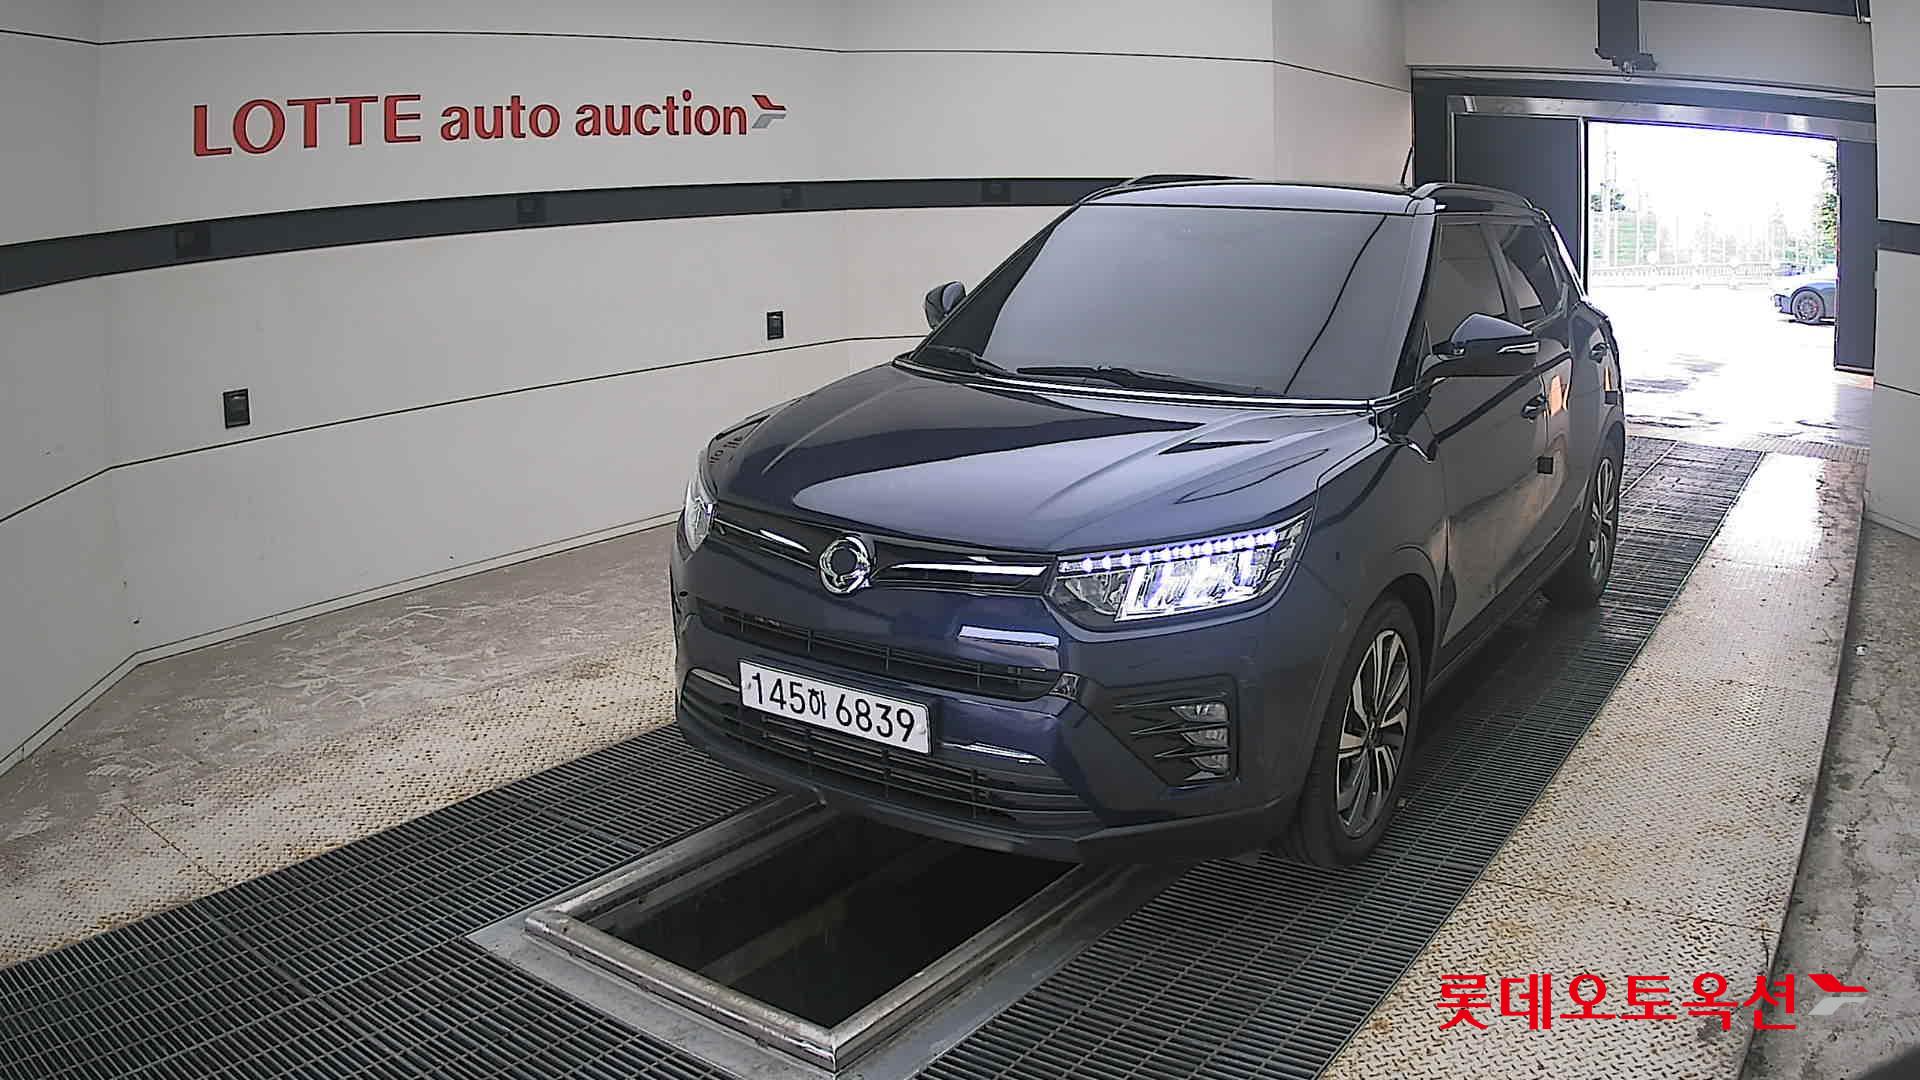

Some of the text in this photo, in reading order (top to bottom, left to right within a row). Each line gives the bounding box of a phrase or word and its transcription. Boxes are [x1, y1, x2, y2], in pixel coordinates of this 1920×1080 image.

[193, 89, 748, 157] LOTTE auto auction
[752, 672, 915, 742] 145하 6839
